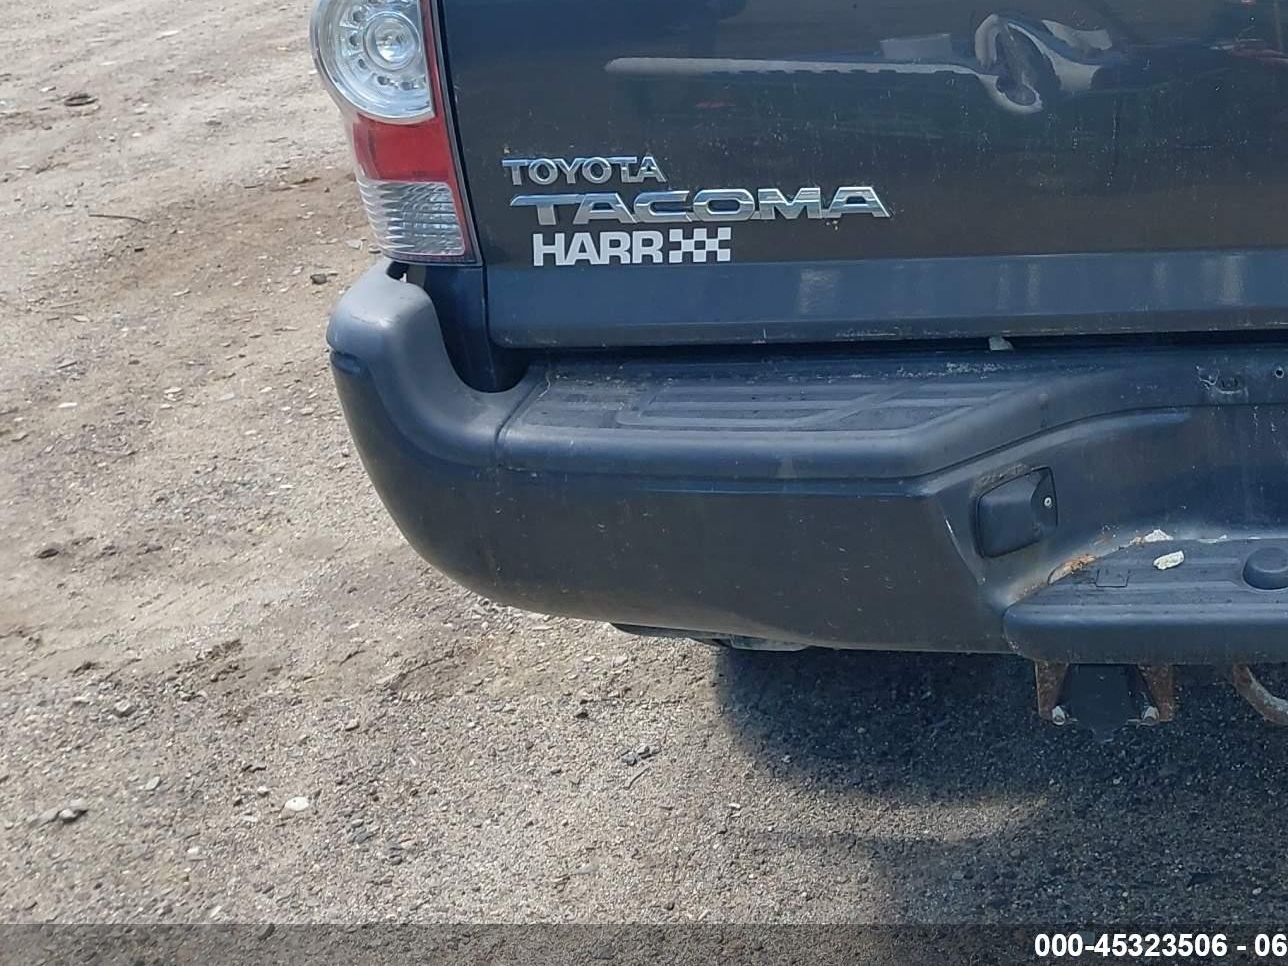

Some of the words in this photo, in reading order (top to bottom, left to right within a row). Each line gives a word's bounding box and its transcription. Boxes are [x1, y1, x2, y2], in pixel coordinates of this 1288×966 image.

[501, 156, 668, 186] TOYOTA
[510, 186, 892, 226] TACOMA
[532, 230, 664, 267] HARR
